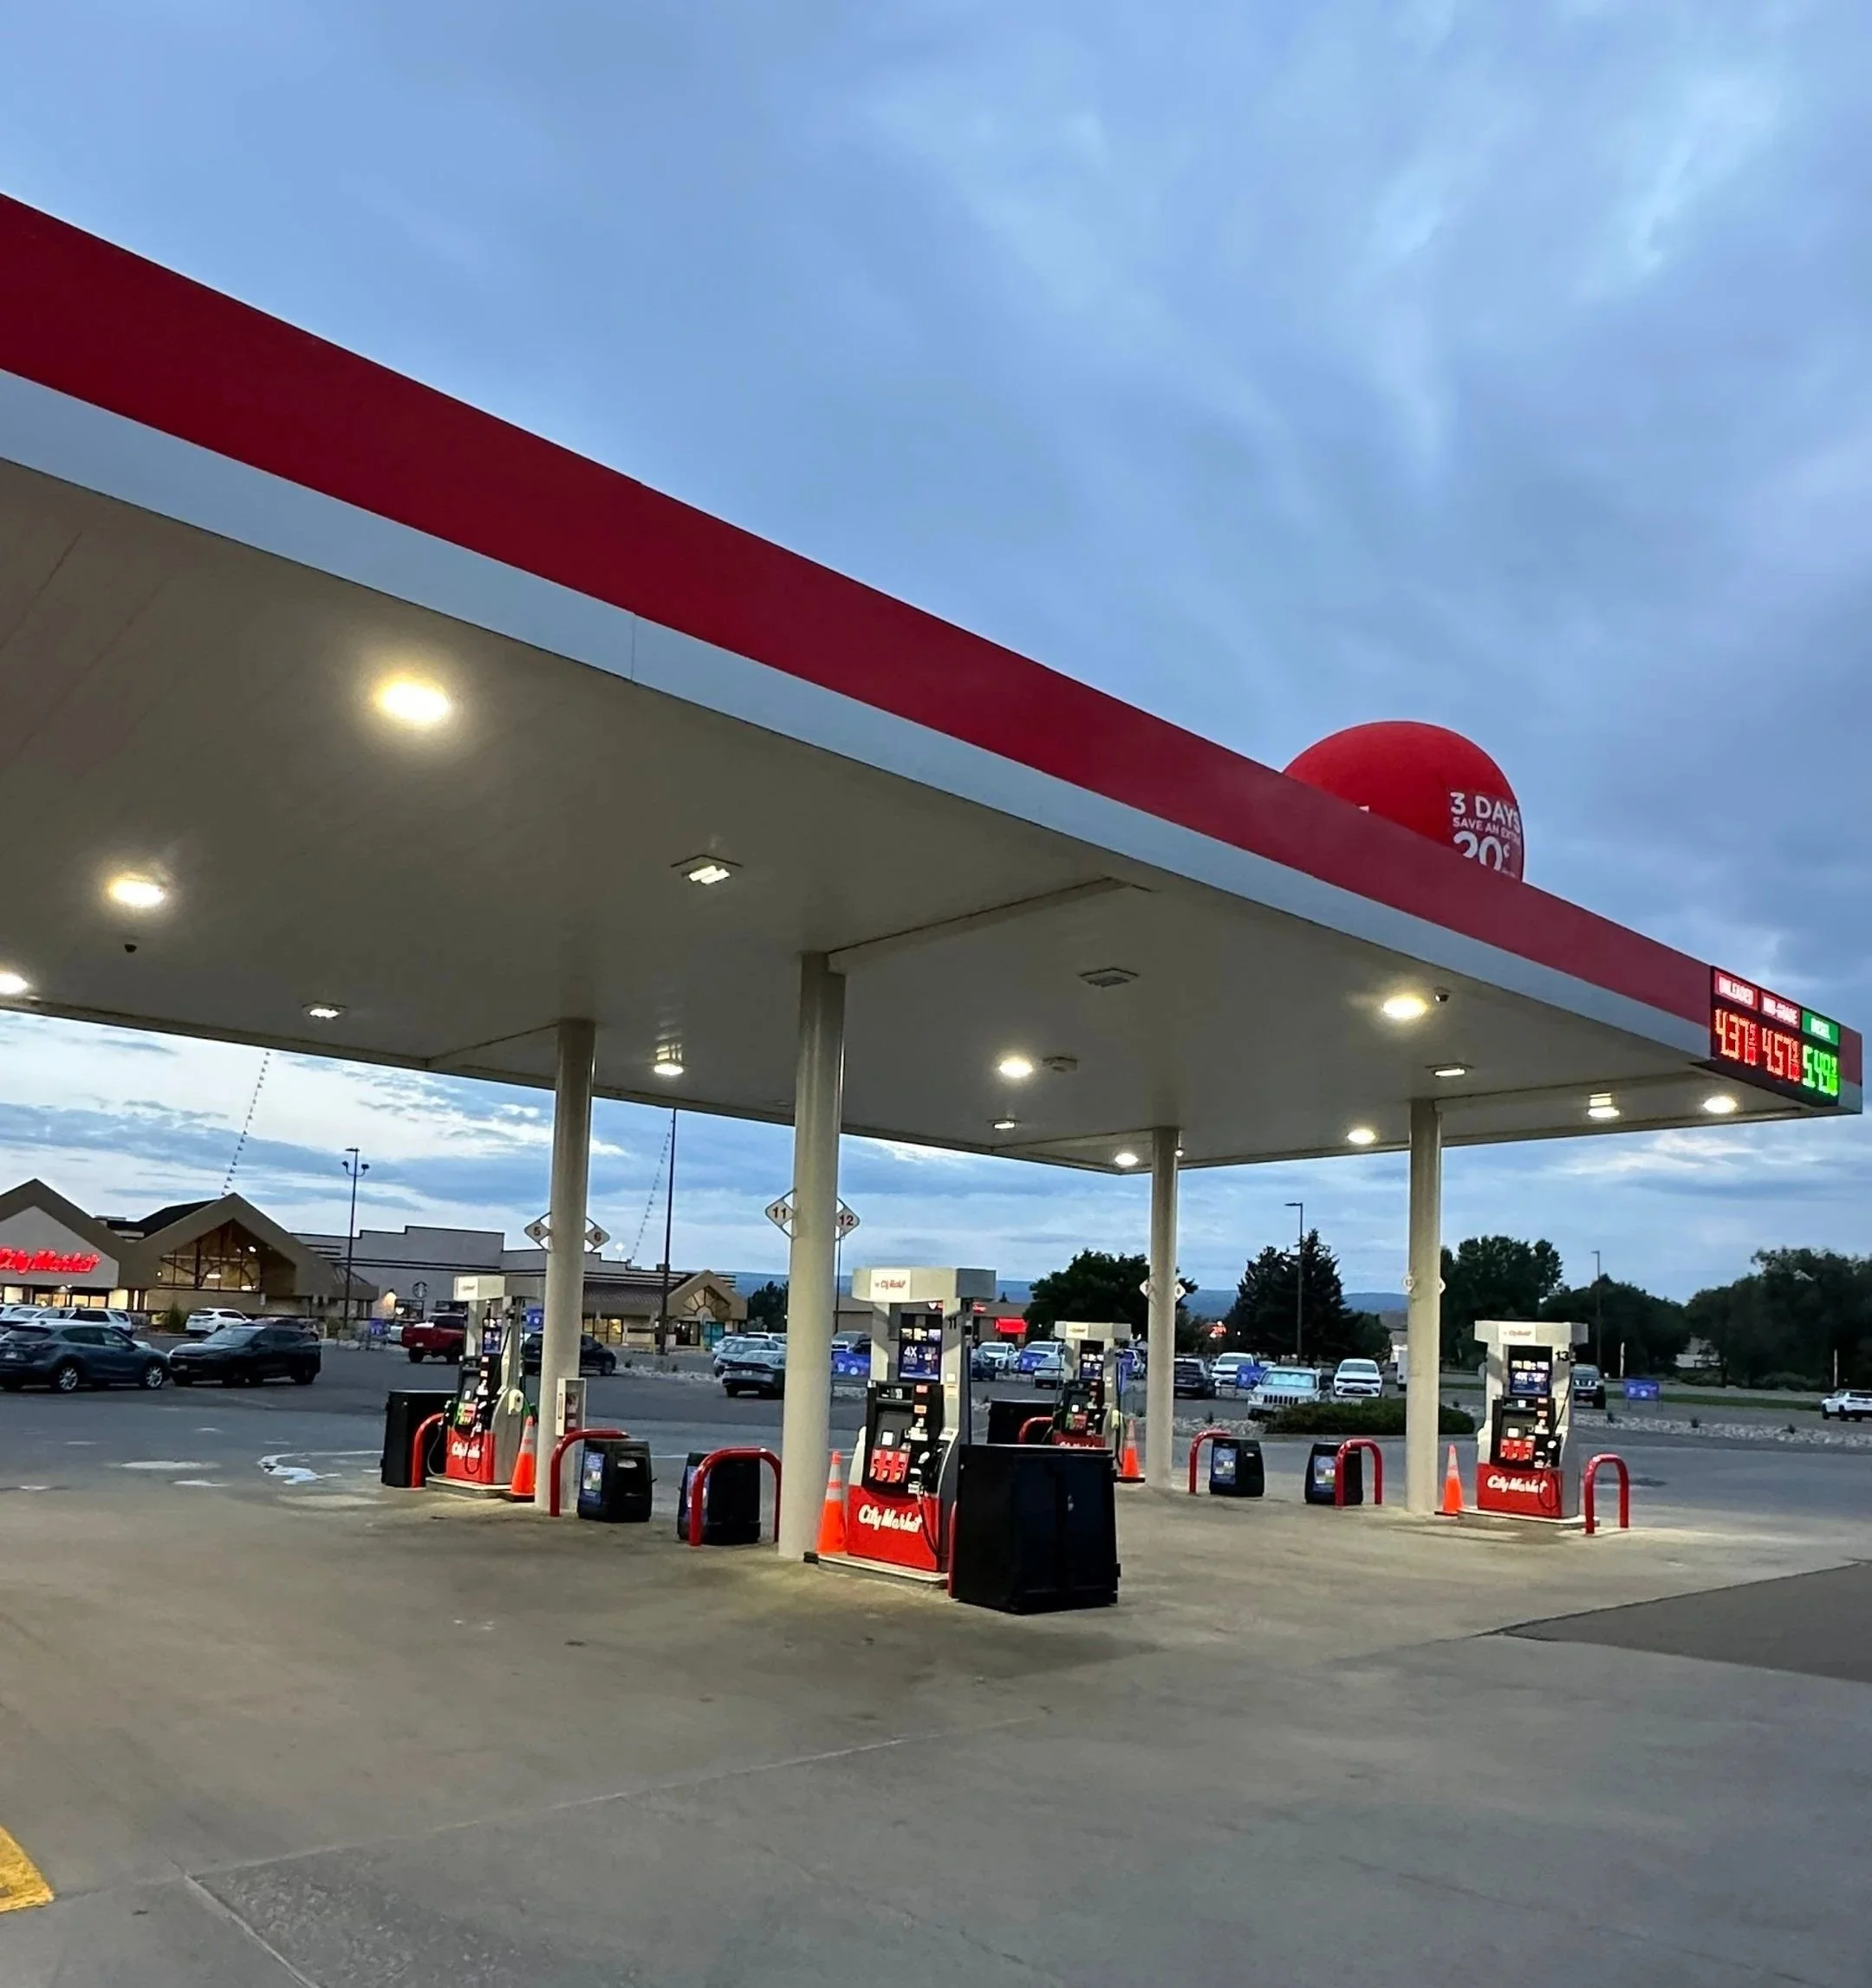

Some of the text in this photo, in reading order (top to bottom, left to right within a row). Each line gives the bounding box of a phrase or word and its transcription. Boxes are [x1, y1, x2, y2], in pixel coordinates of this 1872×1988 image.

[1450, 791, 1466, 815] 3
[1453, 816, 1484, 831] SAVE
[1485, 822, 1499, 835] AN
[773, 1206, 787, 1219] 11
[839, 1214, 854, 1226] 12
[533, 1226, 541, 1237] 5
[904, 1346, 918, 1357] 4X
[1556, 1350, 1570, 1361] 13
[858, 1504, 923, 1534] City Market
